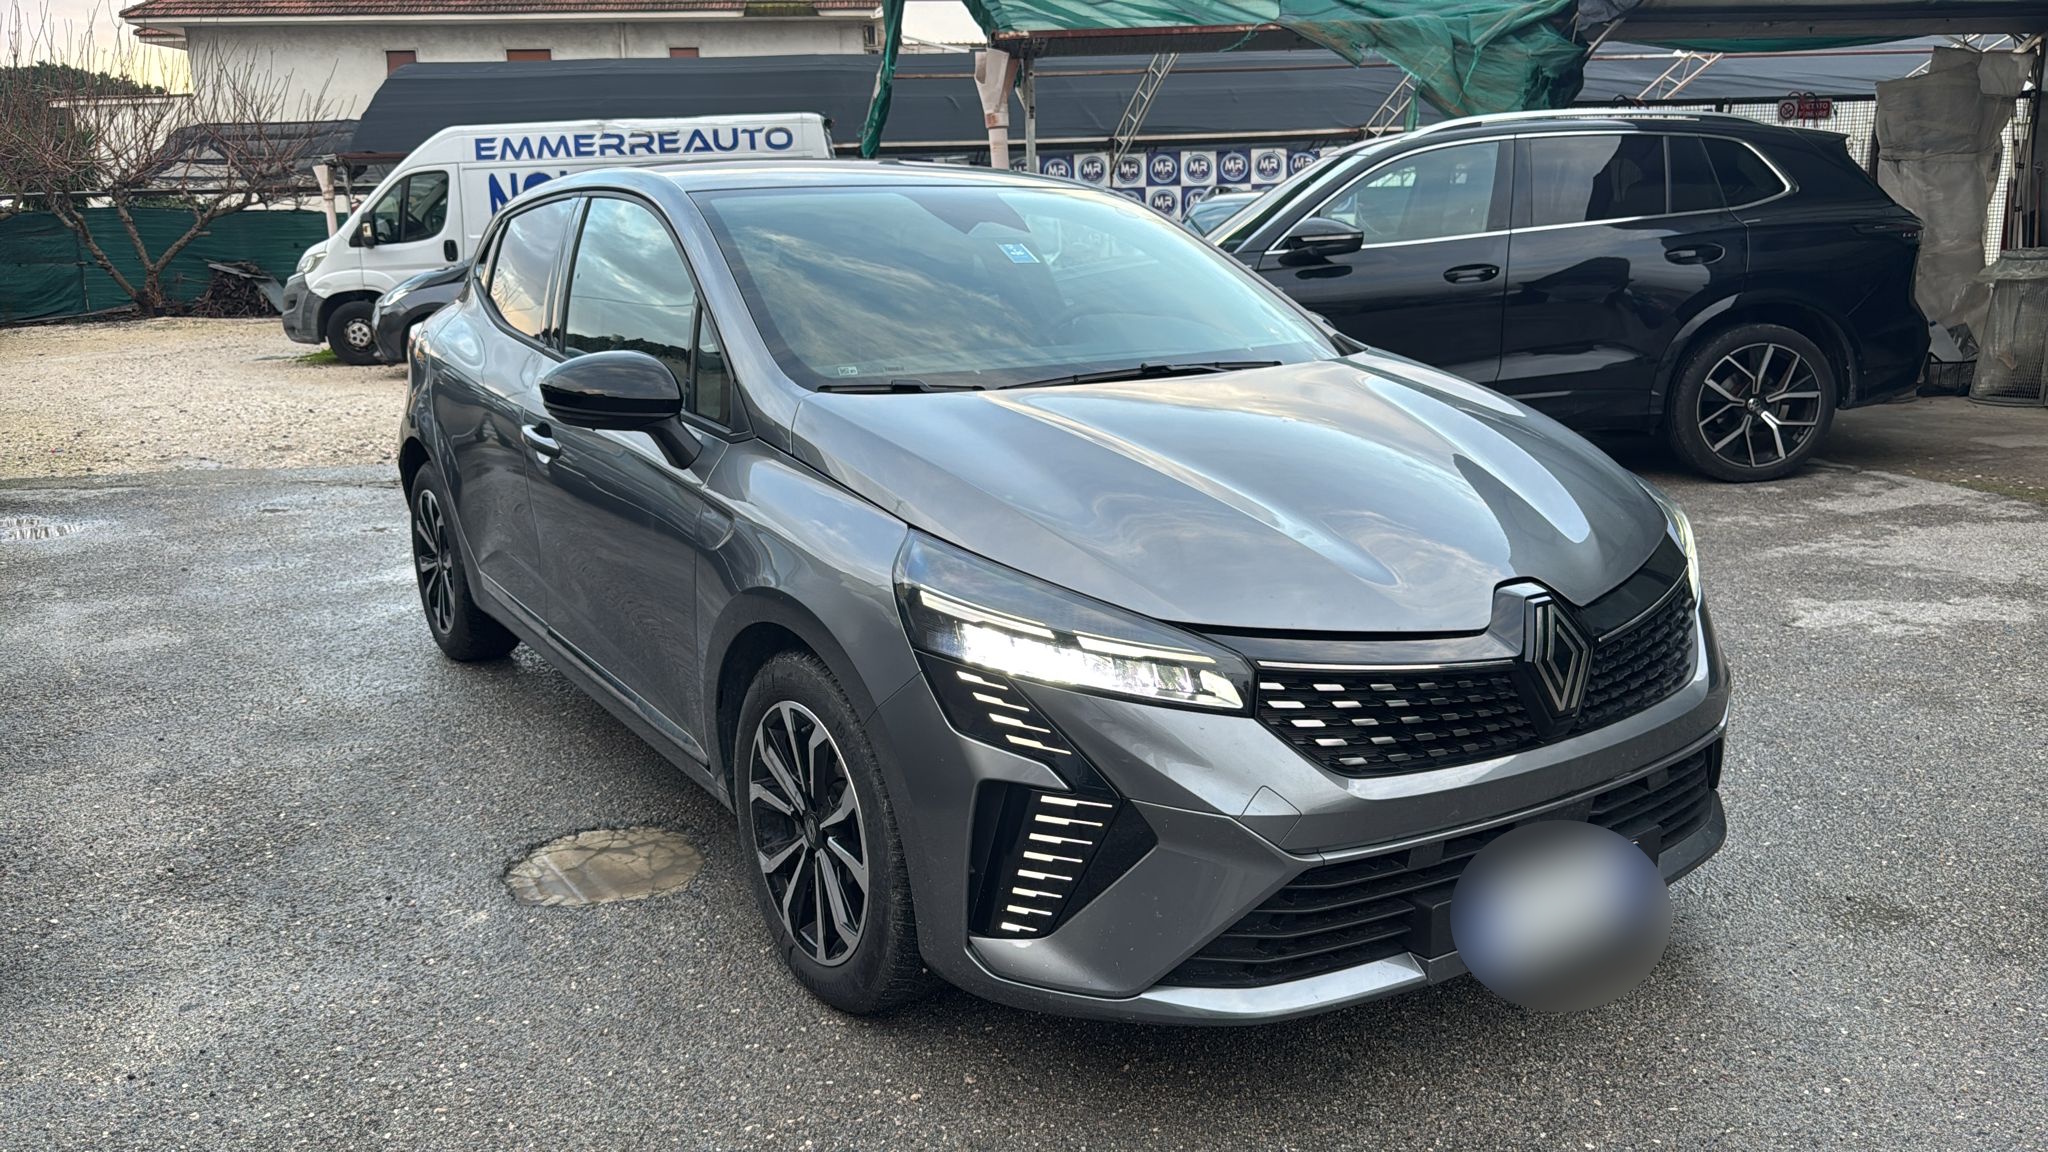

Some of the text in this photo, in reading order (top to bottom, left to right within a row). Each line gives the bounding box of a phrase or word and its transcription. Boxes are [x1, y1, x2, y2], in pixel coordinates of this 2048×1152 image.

[475, 127, 793, 160] EMMERREAUTO
[1083, 161, 1101, 175] MR
[1154, 161, 1173, 174] MR
[1189, 159, 1208, 173] MR
[1225, 159, 1243, 172] MR
[1259, 159, 1278, 172] MR
[1154, 195, 1173, 208] MR
